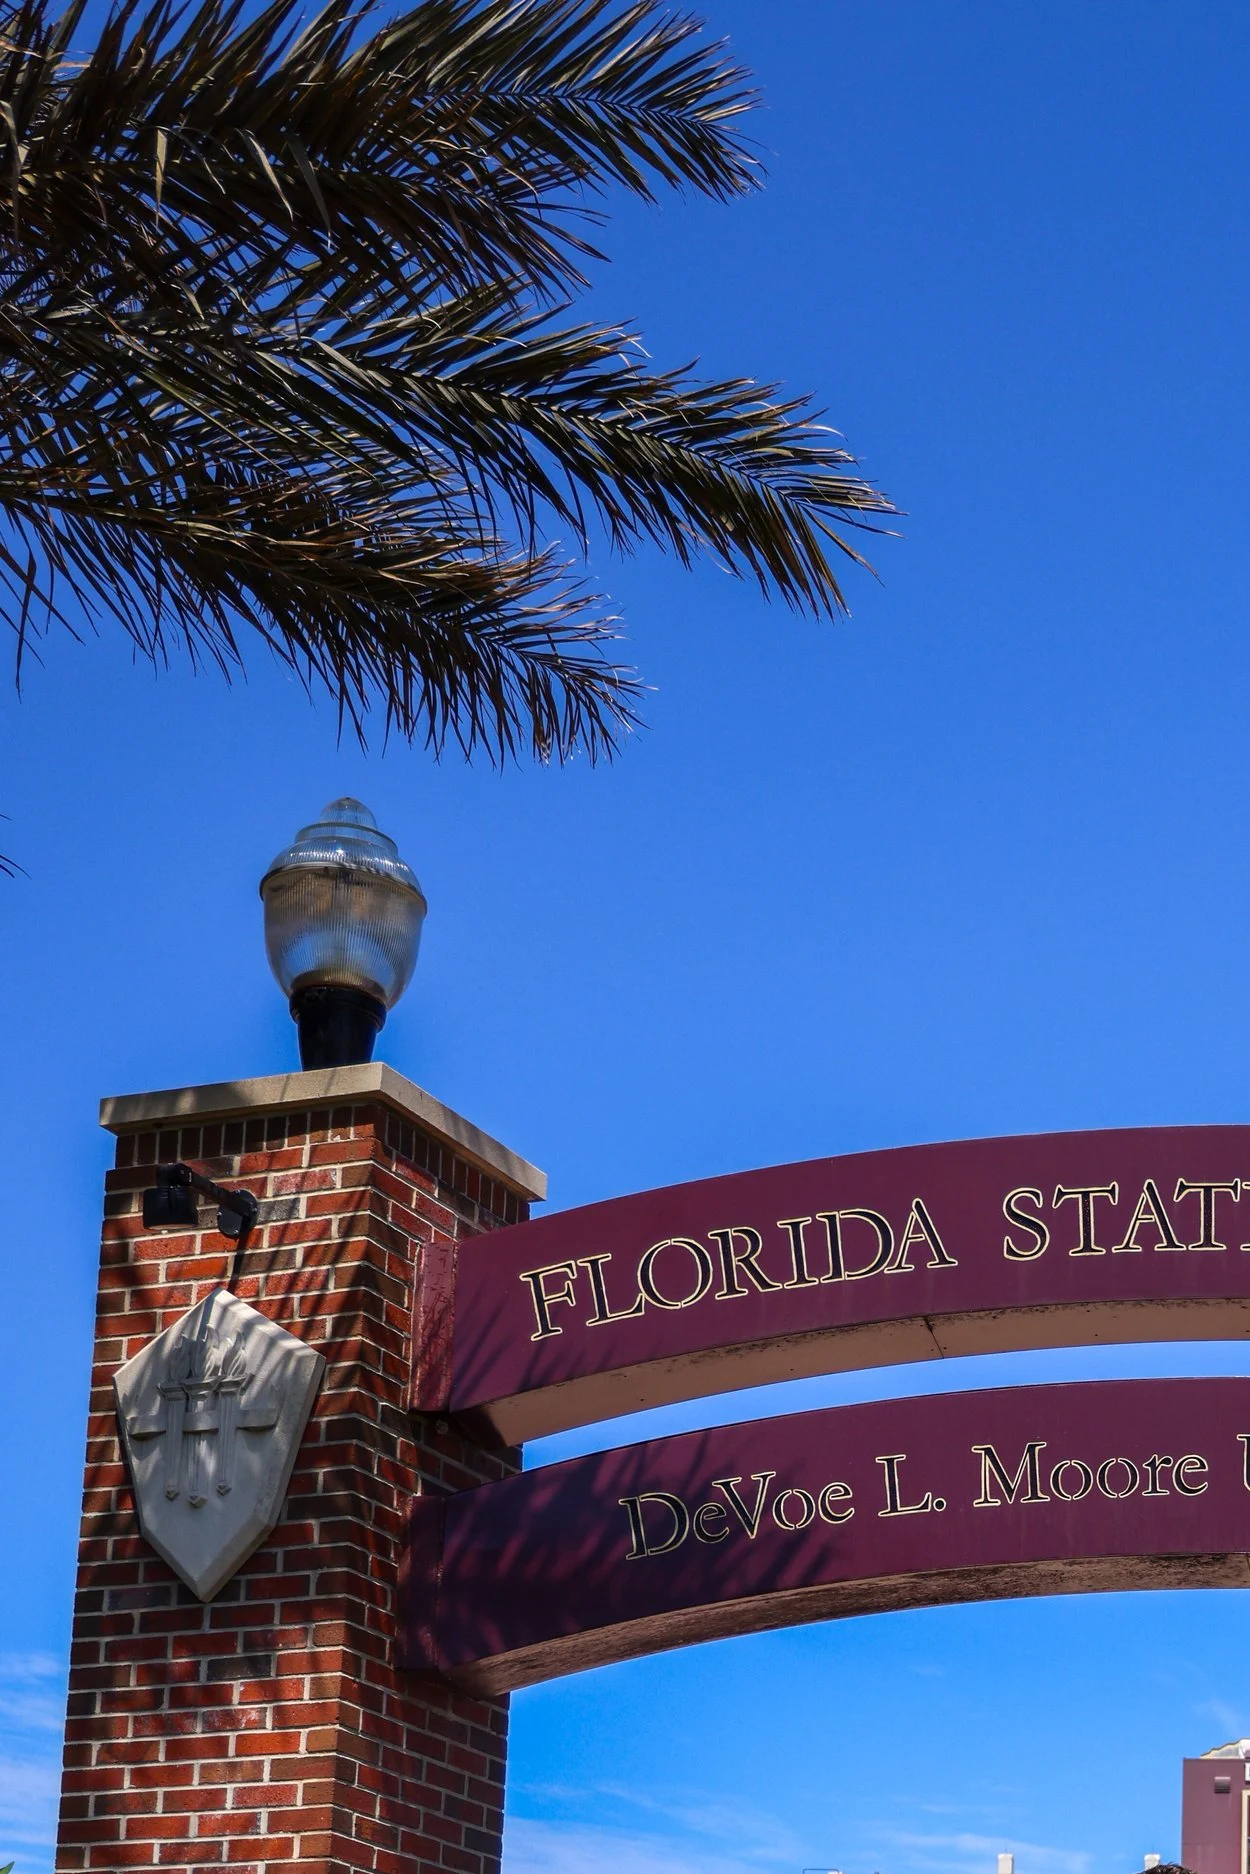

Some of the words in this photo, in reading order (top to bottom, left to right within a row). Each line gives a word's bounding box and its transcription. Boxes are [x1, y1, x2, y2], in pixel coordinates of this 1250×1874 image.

[519, 1198, 957, 1341] FLORIDA
[618, 1471, 855, 1560] DeVoe
[876, 1454, 946, 1517] L.
[972, 1441, 1209, 1508] Moore
